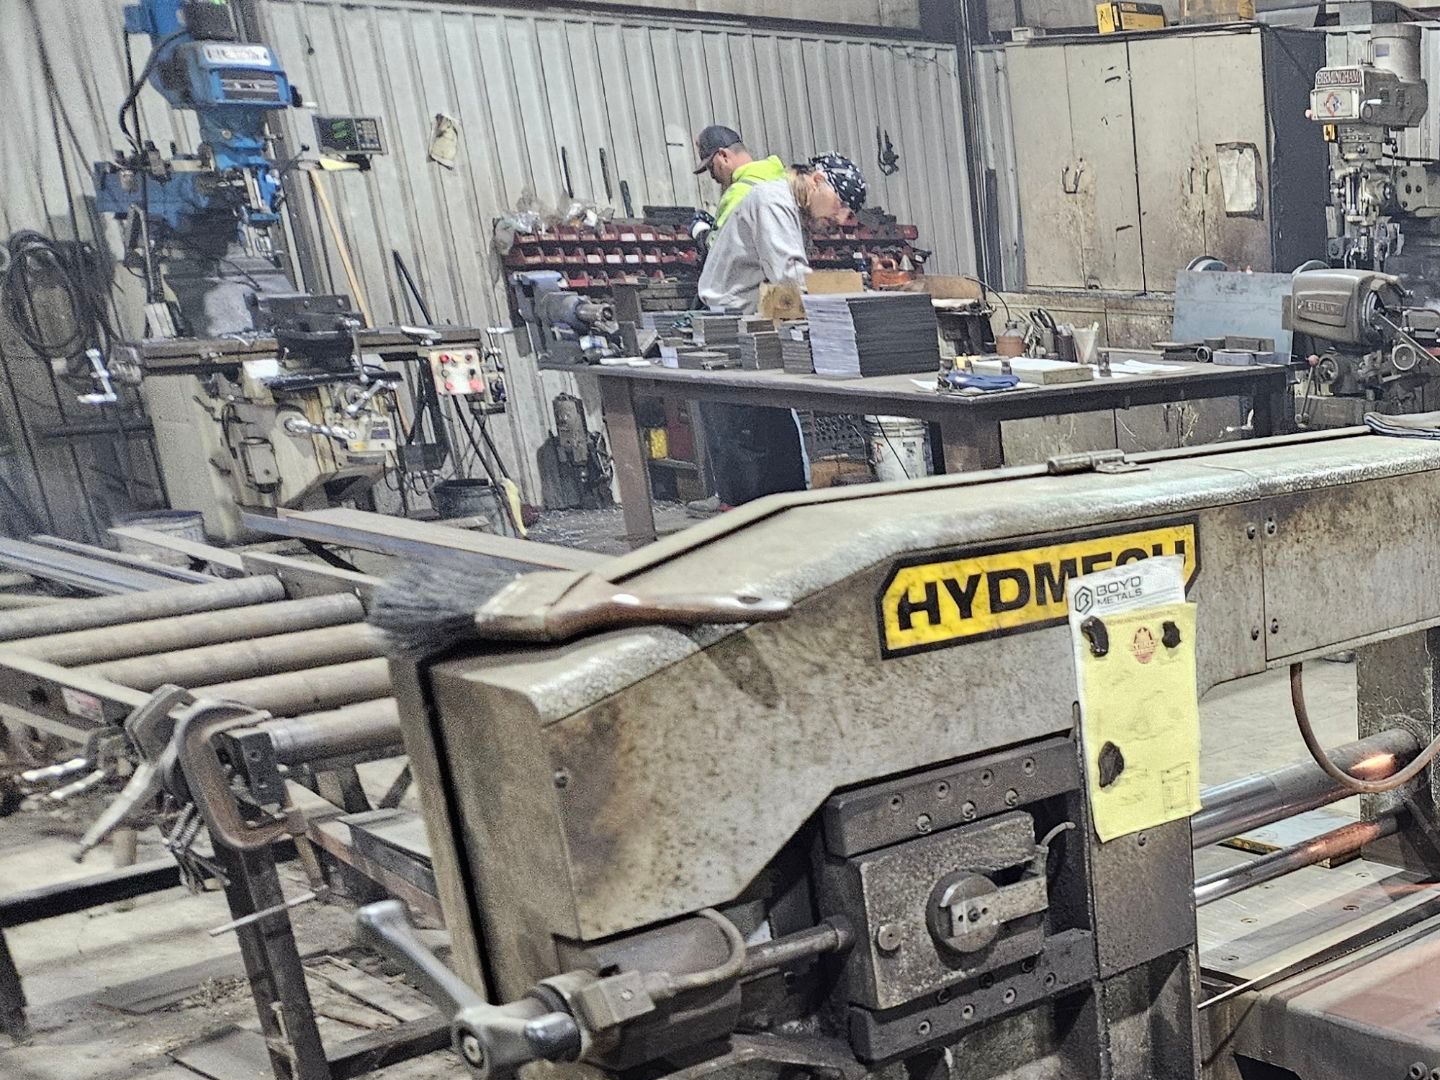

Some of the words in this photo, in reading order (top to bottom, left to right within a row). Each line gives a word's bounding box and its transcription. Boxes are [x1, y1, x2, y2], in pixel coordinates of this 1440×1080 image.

[1317, 70, 1361, 85] BIRMINGHAM
[1096, 575, 1142, 597] BOYD
[1097, 587, 1143, 606] METALS
